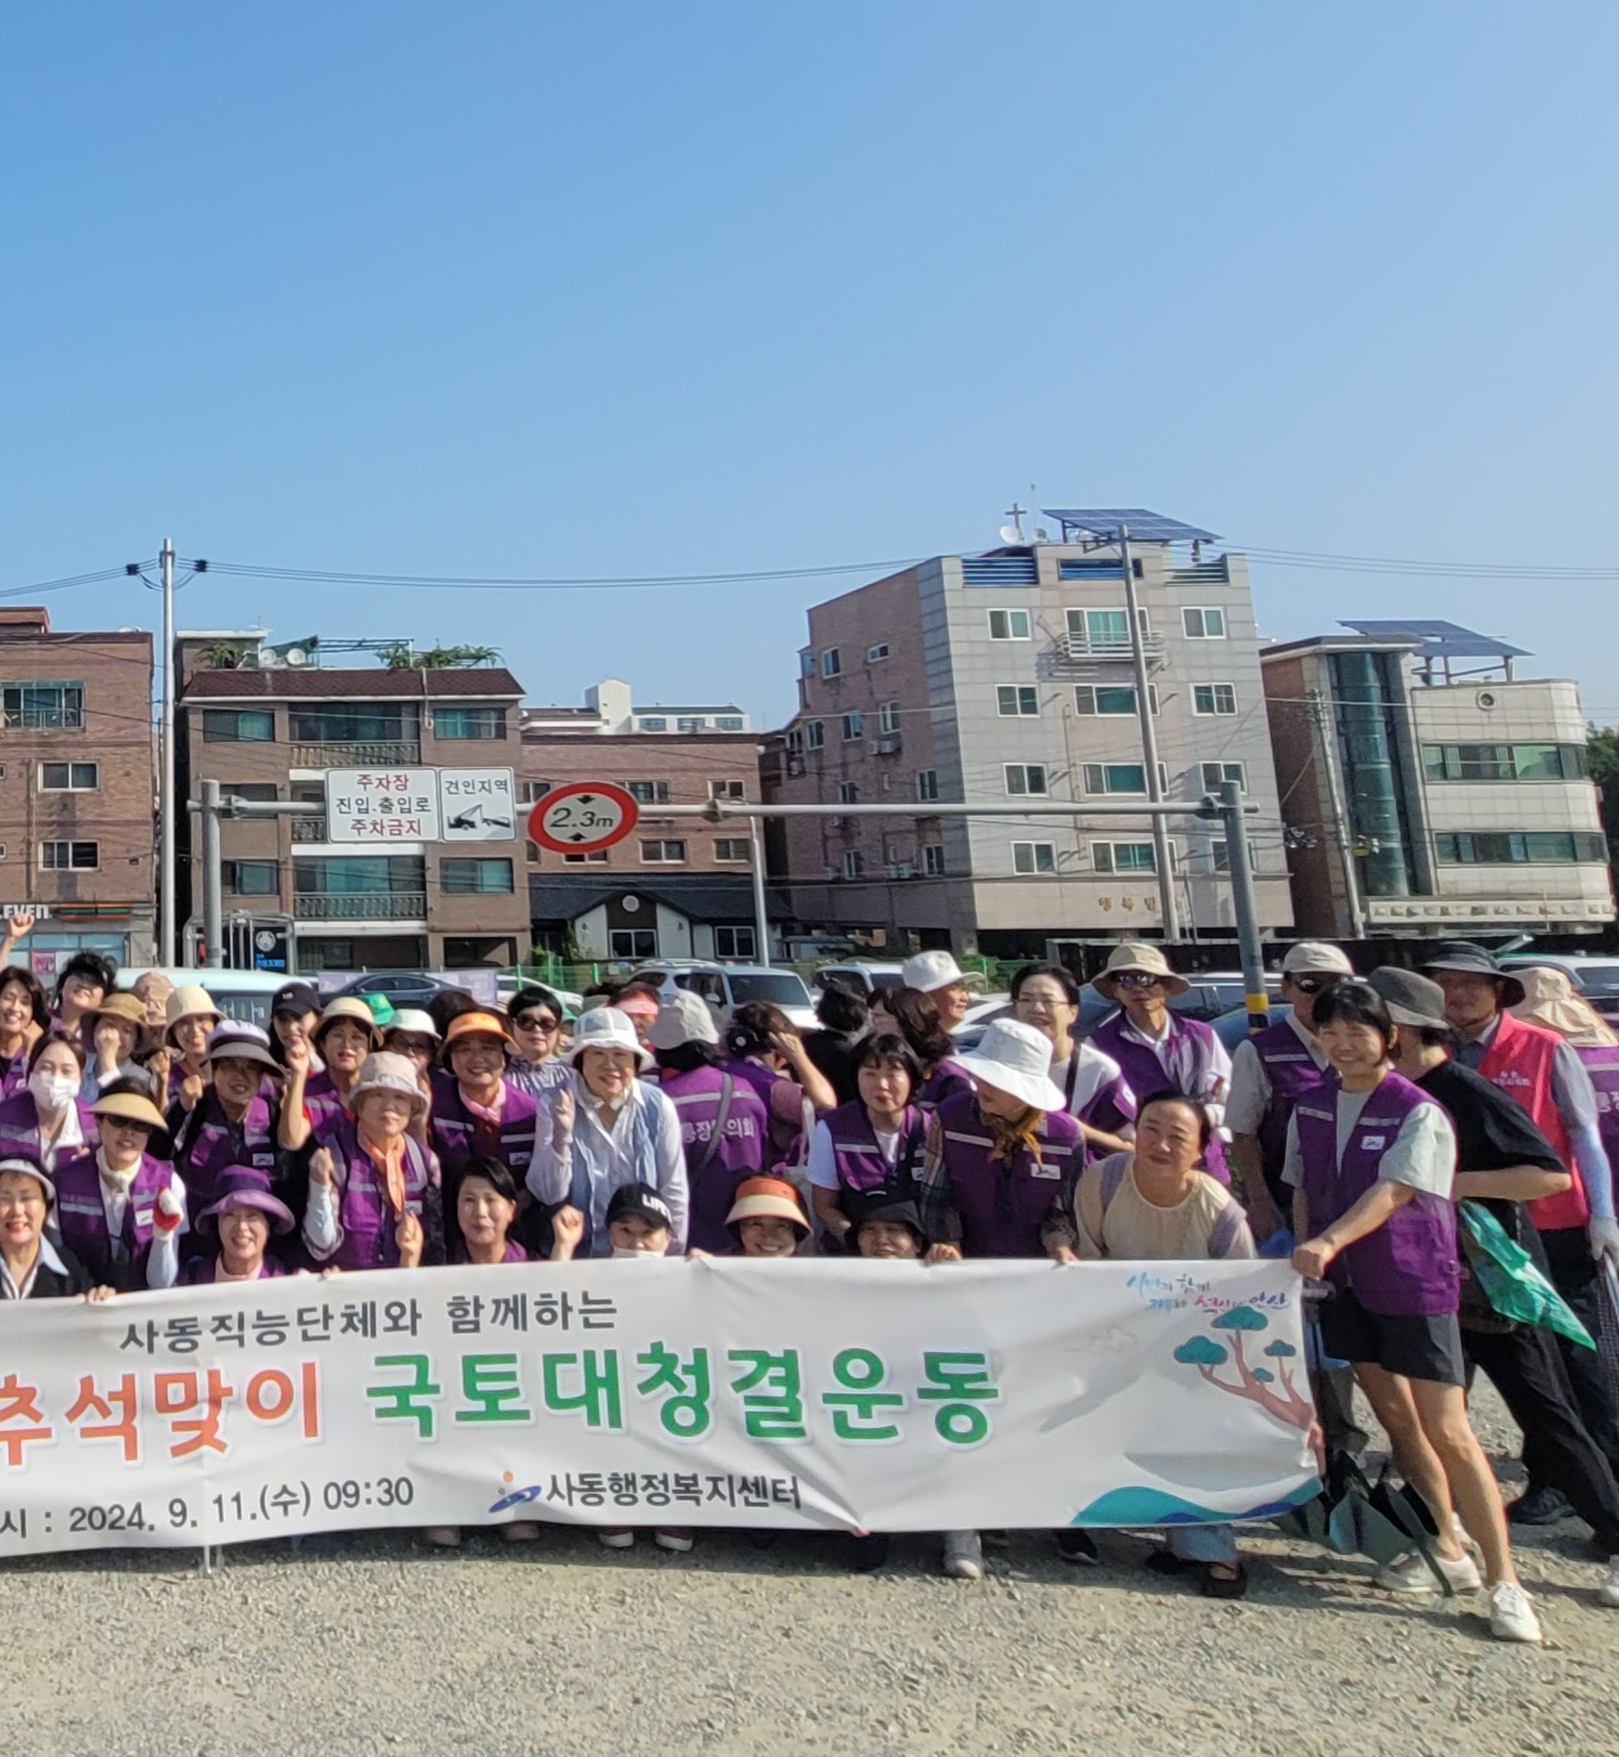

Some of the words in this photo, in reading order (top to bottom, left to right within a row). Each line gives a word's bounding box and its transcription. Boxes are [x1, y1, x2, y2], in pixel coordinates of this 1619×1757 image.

[445, 778, 509, 795] 견인지역
[350, 818, 422, 837] 주차금지
[549, 807, 614, 828] 2.3m
[119, 1297, 422, 1354] 사동직능단체와
[446, 1290, 618, 1335] 함께하는
[365, 1339, 999, 1446] 국토대청결운동
[69, 1504, 156, 1533] 2024.
[323, 1475, 415, 1510] 09:30
[546, 1471, 803, 1513] 사동행정복지센터
